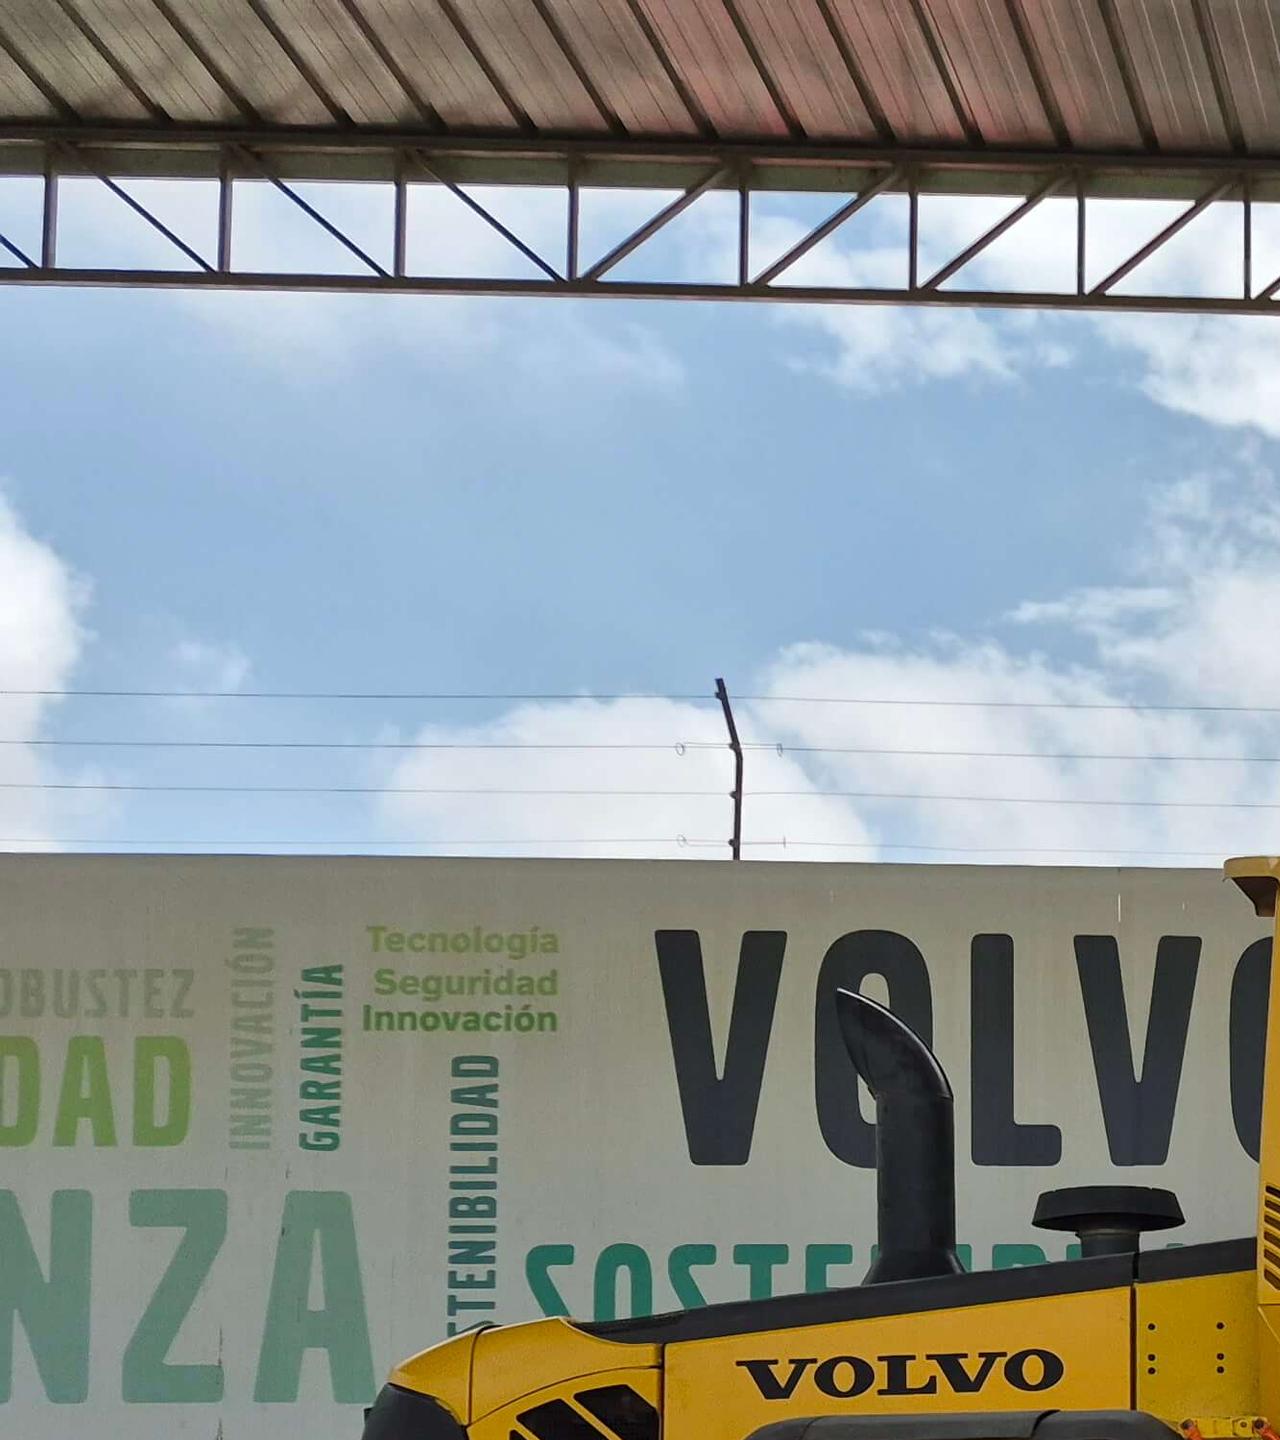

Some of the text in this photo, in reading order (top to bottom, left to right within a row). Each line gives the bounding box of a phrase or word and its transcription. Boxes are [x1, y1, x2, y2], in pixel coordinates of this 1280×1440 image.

[366, 925, 560, 960] Tecnología
[362, 1004, 558, 1033] Innovación
[374, 967, 559, 1001] Seguridad
[225, 927, 275, 1150] INNOVACIÓN
[294, 963, 344, 1152] GARANTÍA
[0, 1034, 192, 1147] DAD
[0, 1188, 377, 1404] NZA
[736, 1348, 1064, 1400] VOLVO
